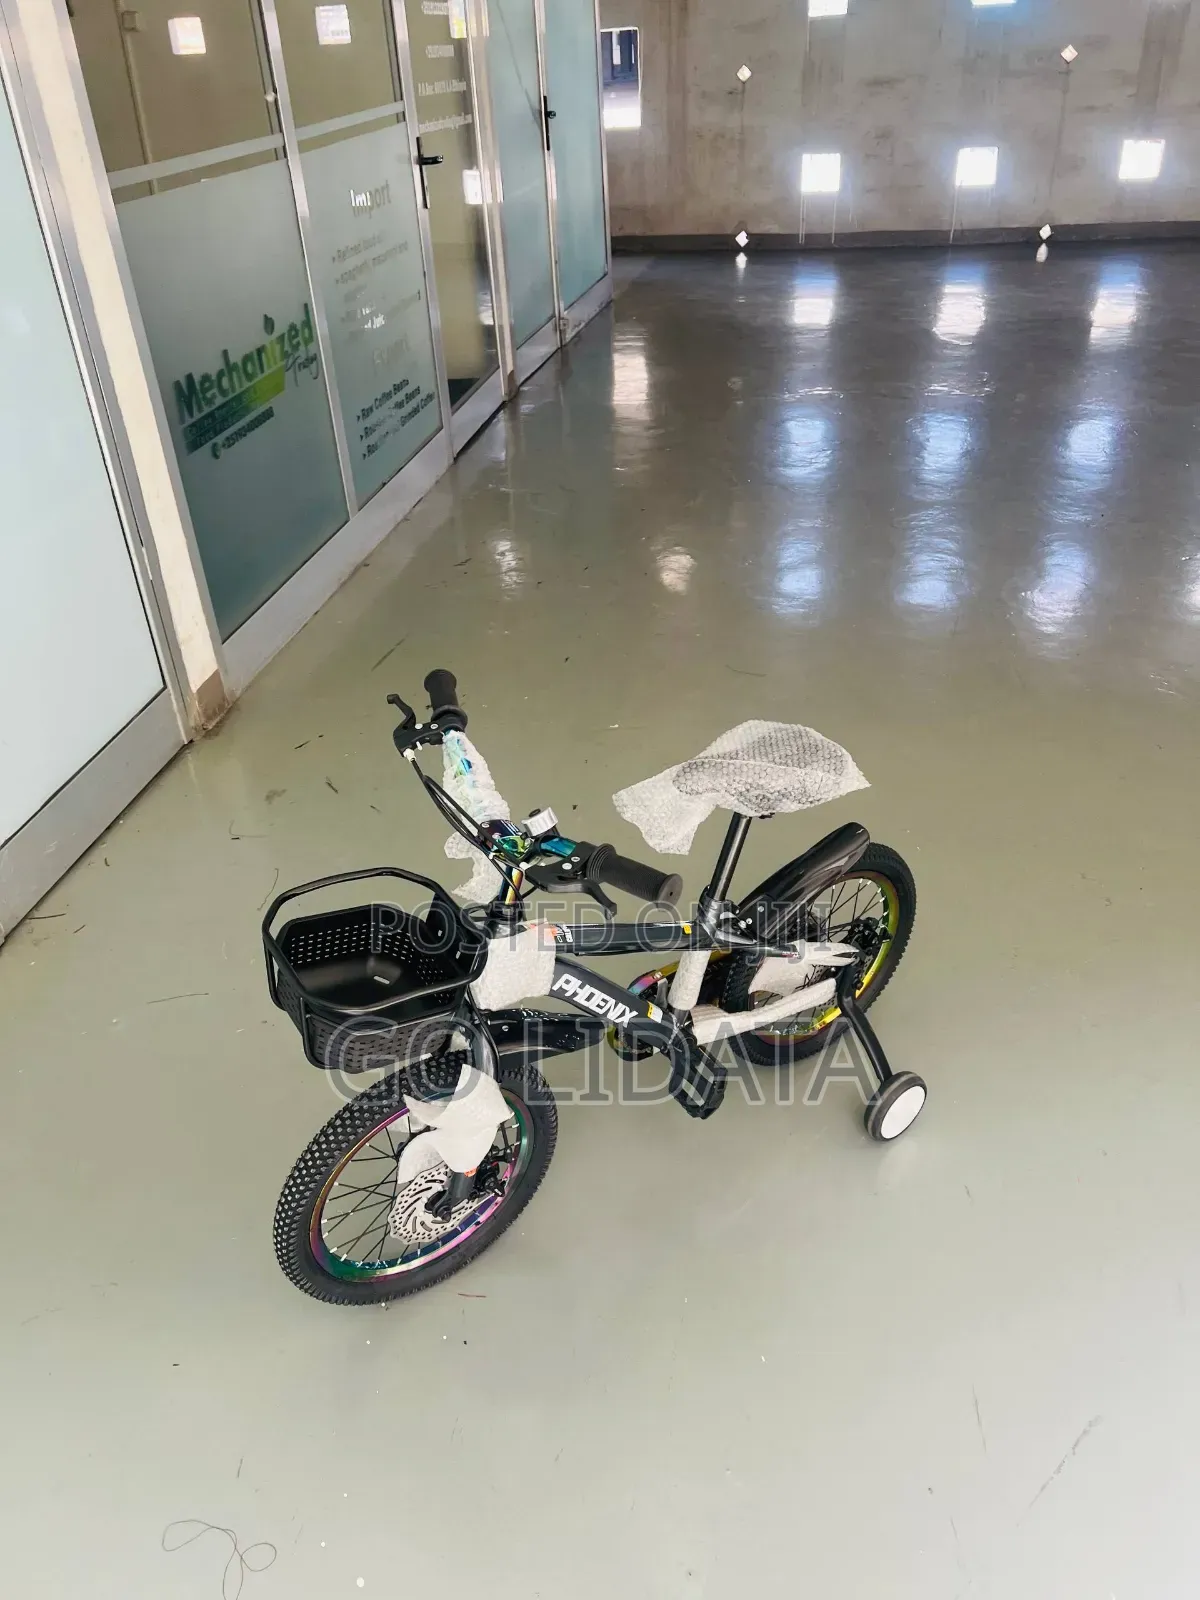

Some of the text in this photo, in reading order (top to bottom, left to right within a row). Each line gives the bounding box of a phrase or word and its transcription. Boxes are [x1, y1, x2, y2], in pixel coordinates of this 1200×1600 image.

[348, 180, 391, 219] Import
[173, 303, 314, 425] Mechanized
[361, 405, 374, 421] Raw
[551, 973, 639, 1029] PHOENIX
